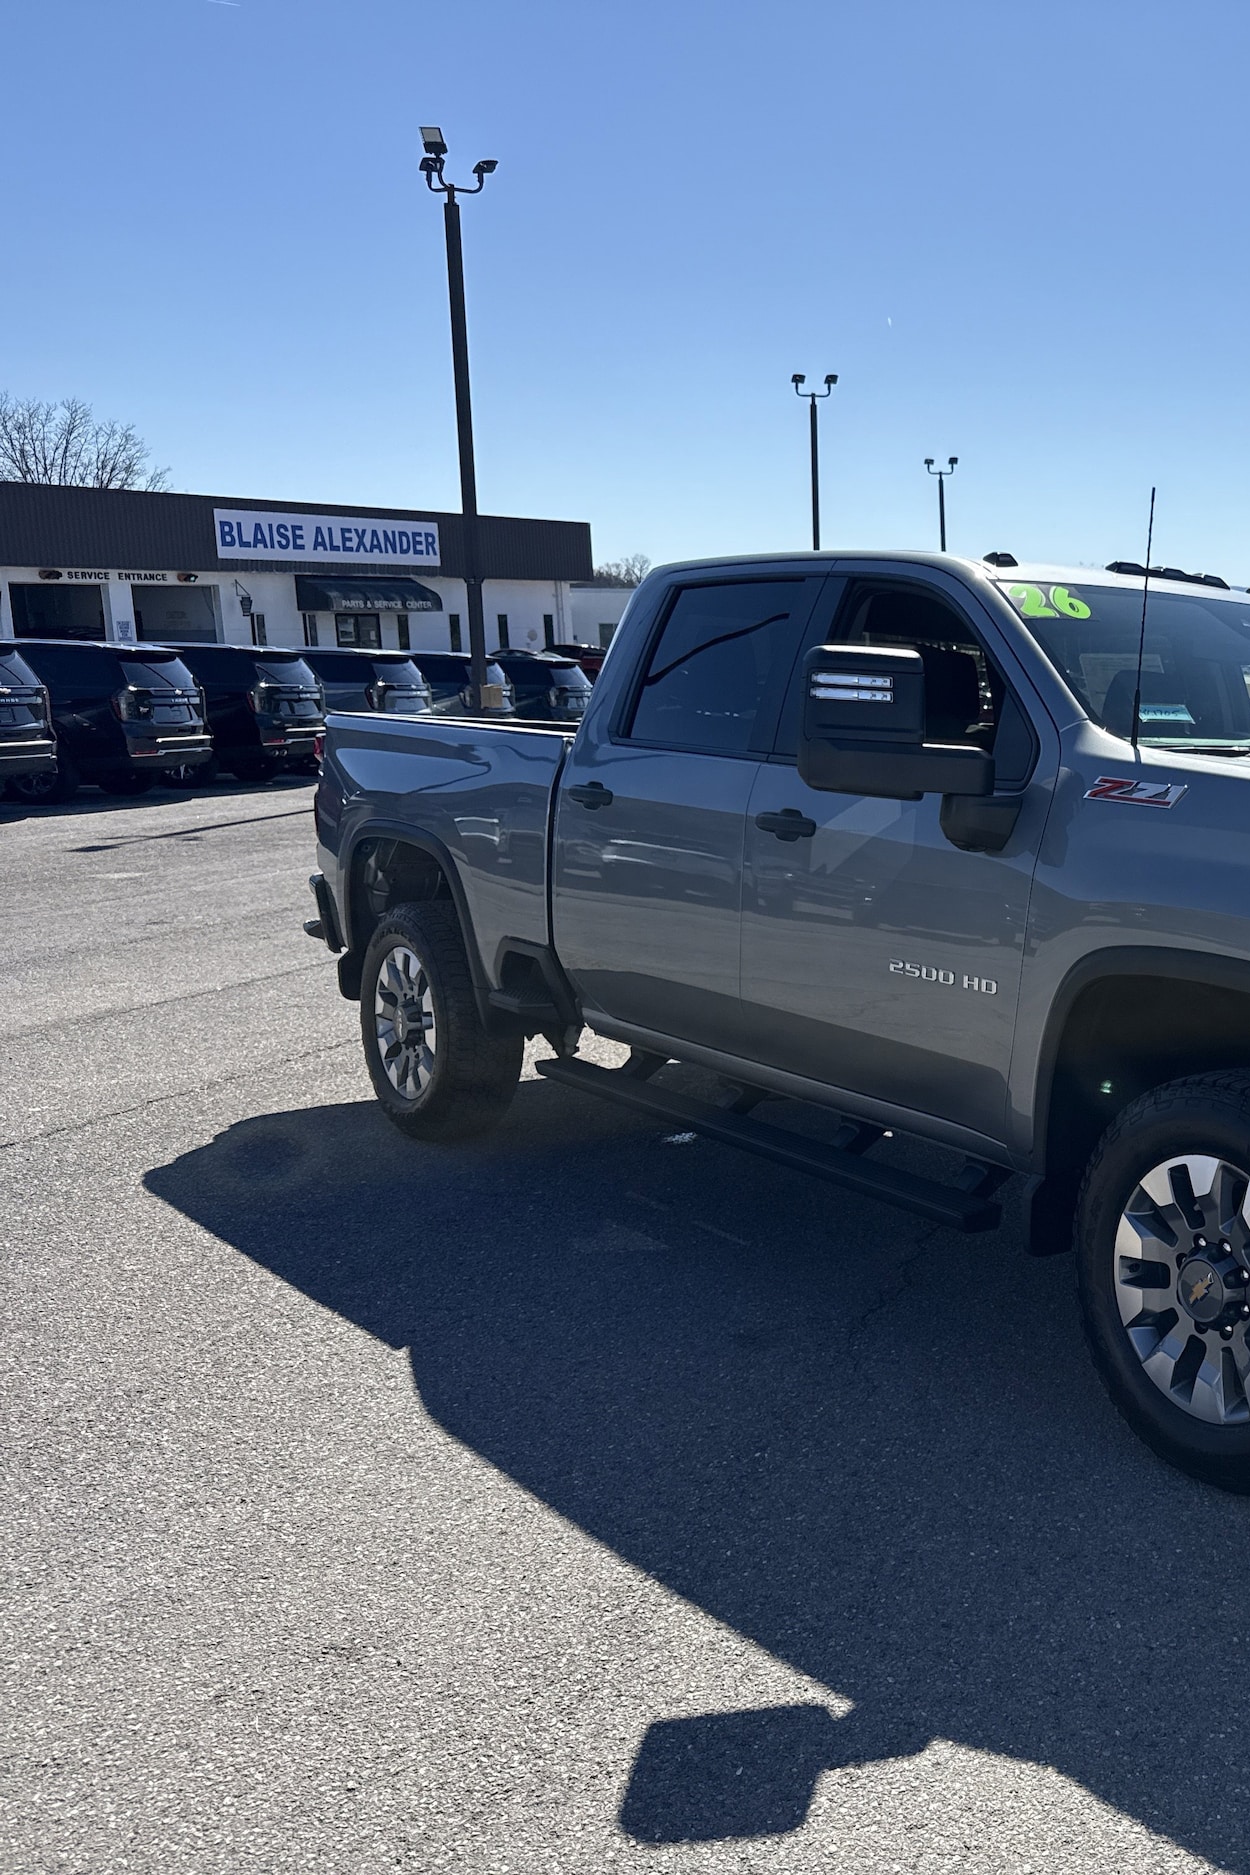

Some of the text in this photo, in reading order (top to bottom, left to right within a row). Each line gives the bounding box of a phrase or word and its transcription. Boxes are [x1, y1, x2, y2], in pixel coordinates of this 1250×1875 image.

[218, 520, 438, 556] BLAISE ALEXANDER
[67, 571, 168, 582] SERVICE ENTRANCE
[341, 599, 433, 610] PARTS & SERVICE CENTER
[1008, 584, 1092, 619] 26
[1083, 776, 1190, 810] Z71
[888, 958, 998, 995] 2500 HD
